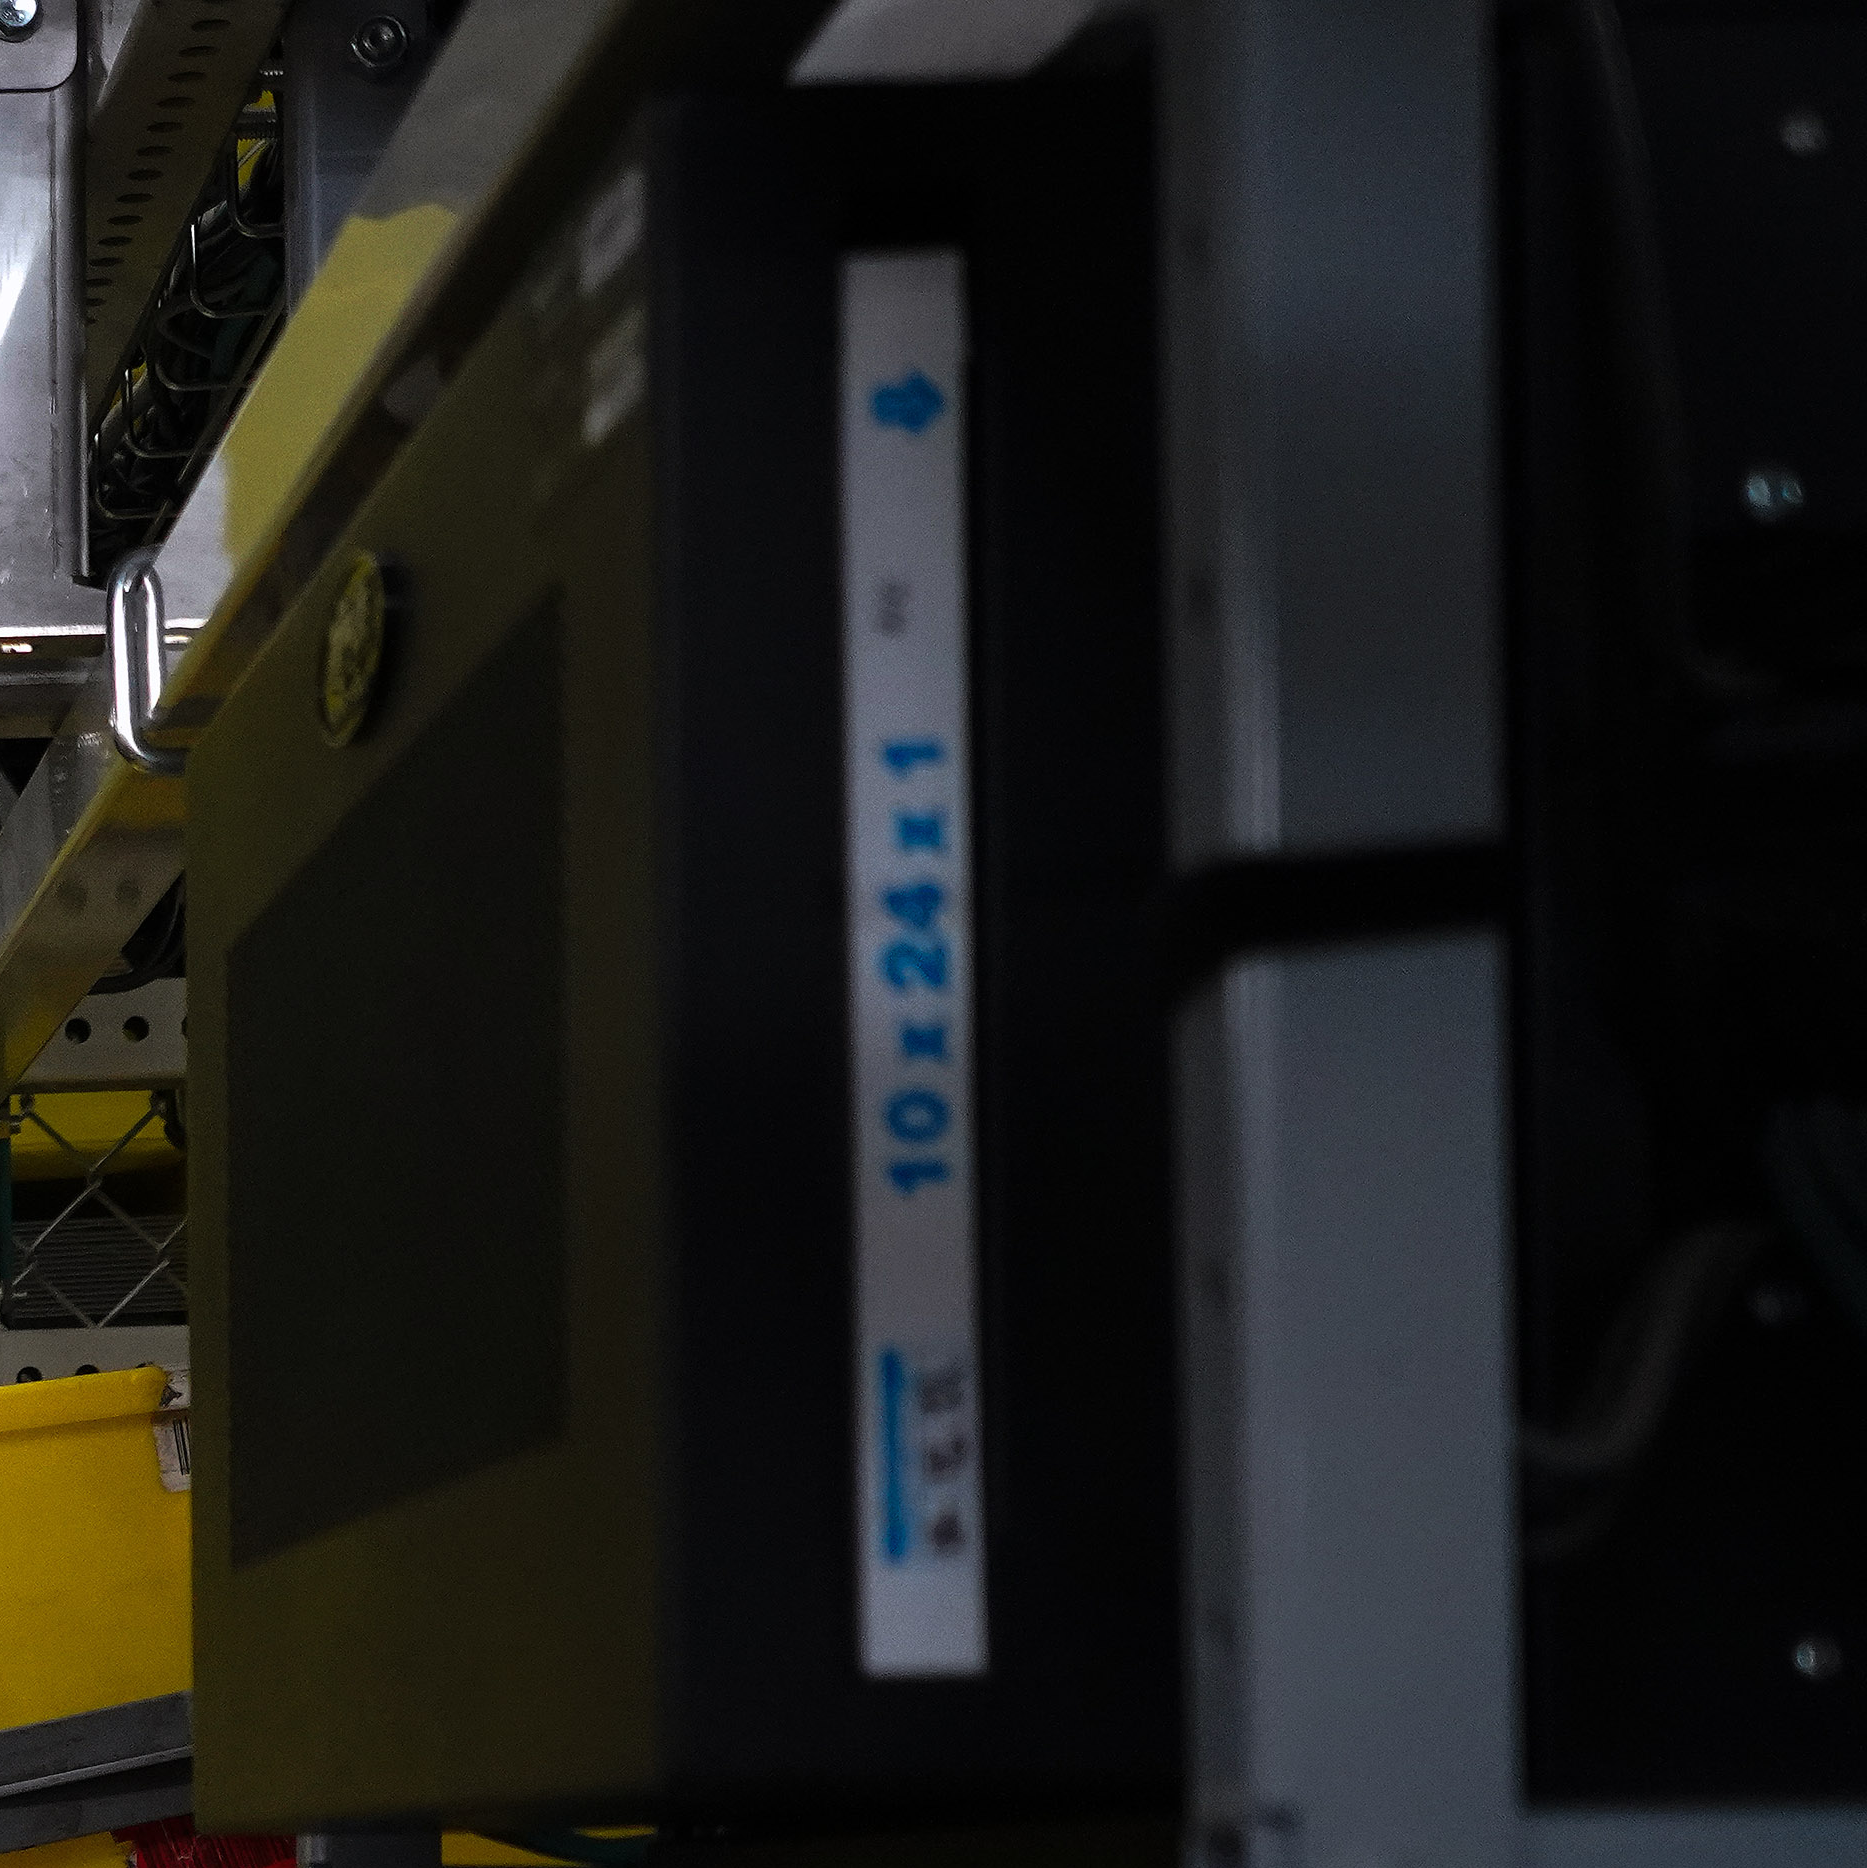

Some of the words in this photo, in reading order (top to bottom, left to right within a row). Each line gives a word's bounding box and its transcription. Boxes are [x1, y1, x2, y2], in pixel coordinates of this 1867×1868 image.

[884, 743, 941, 772] 1
[885, 884, 946, 986] 24
[886, 1089, 947, 1194] 10
